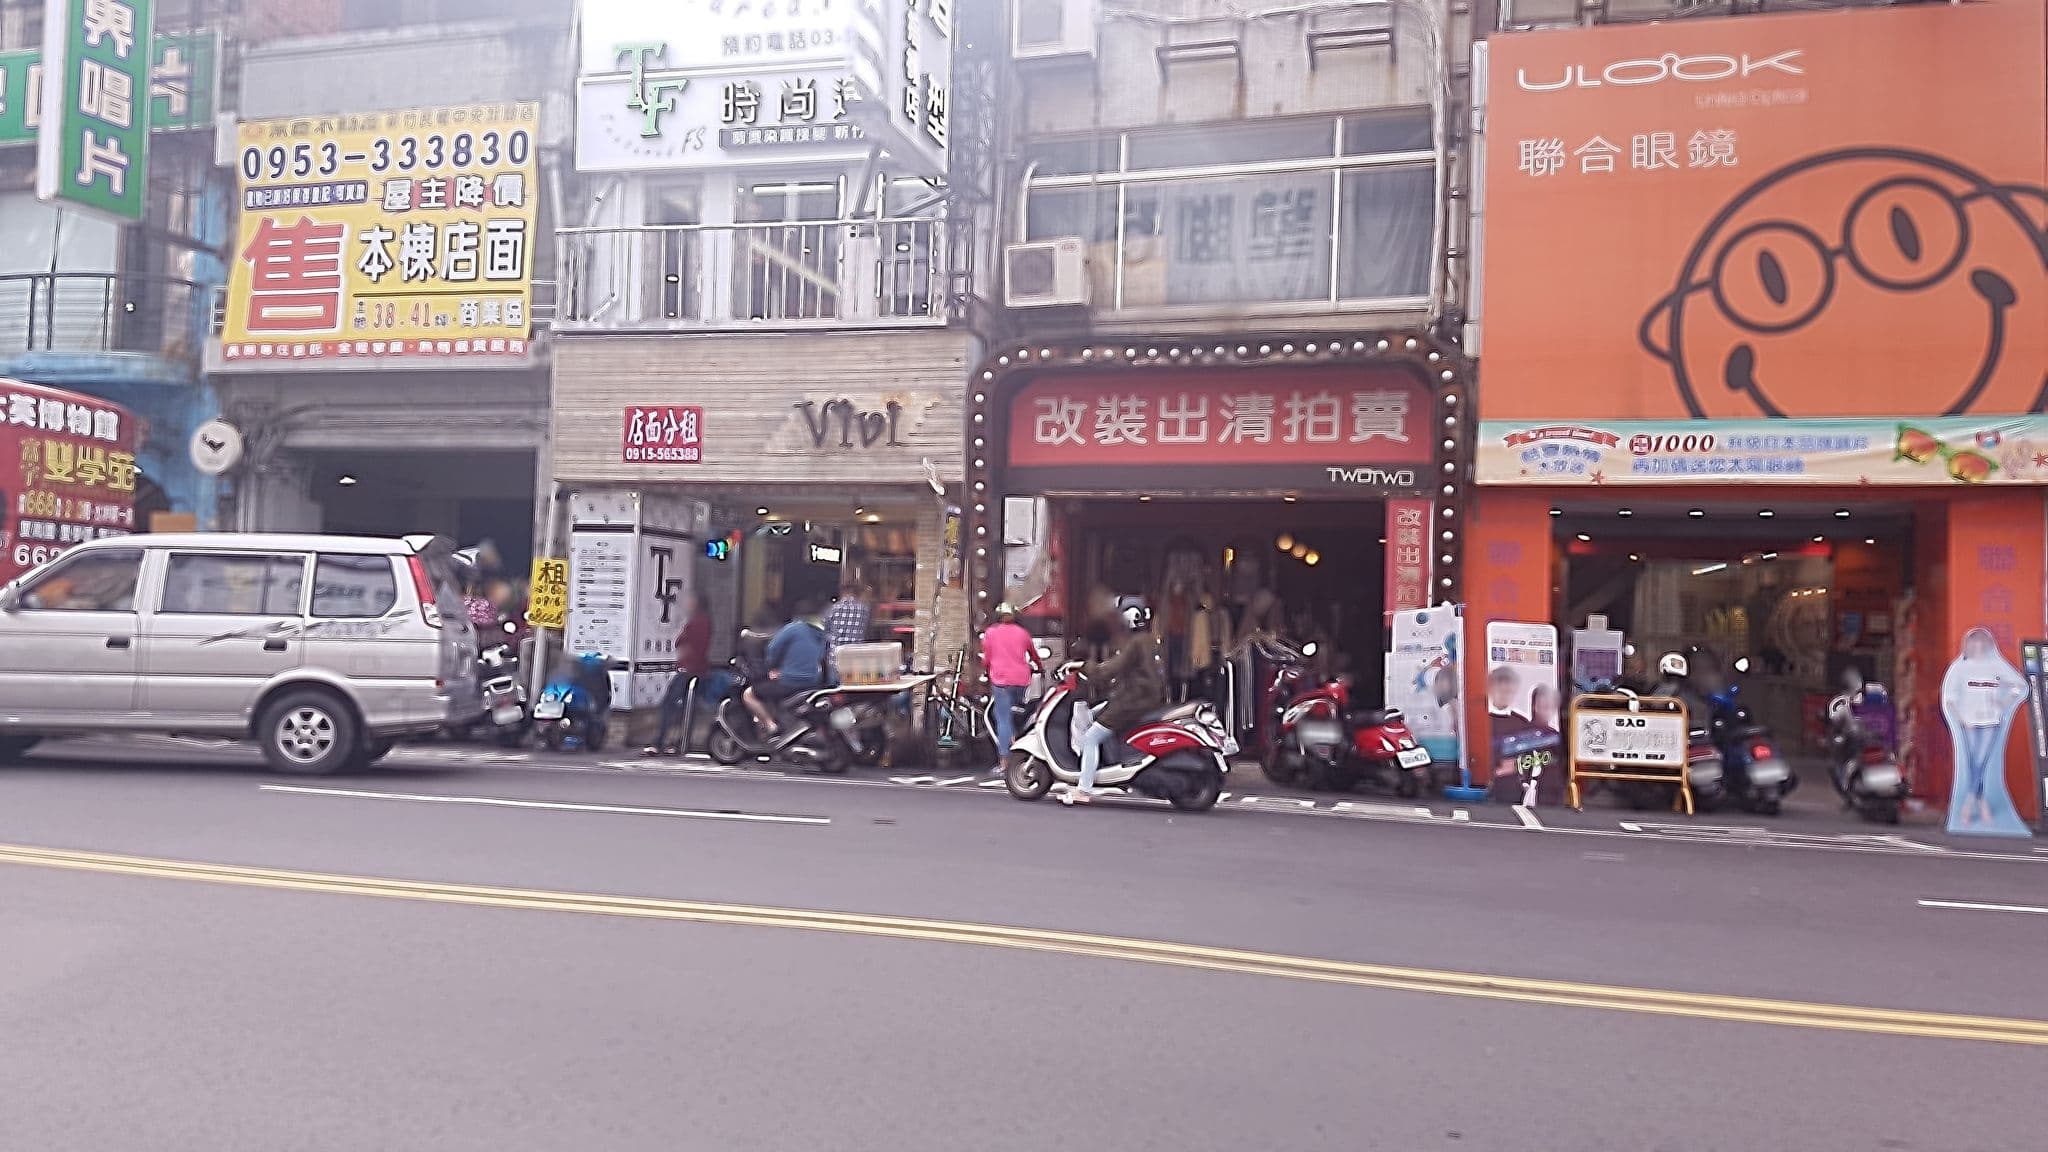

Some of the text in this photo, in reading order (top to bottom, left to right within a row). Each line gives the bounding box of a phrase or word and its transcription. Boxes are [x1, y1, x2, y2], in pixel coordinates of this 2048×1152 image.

[1517, 49, 1805, 90] ULOOK
[242, 130, 530, 181] 0953-333830
[1517, 128, 1739, 177] 聯合眼鏡
[242, 215, 347, 334] 售
[356, 219, 526, 283] 本棟店面
[626, 408, 699, 446] 店面分租
[1033, 390, 1412, 447] 改裝出清拍賣
[1326, 467, 1415, 486] TWOTWO
[538, 561, 567, 585] 租
